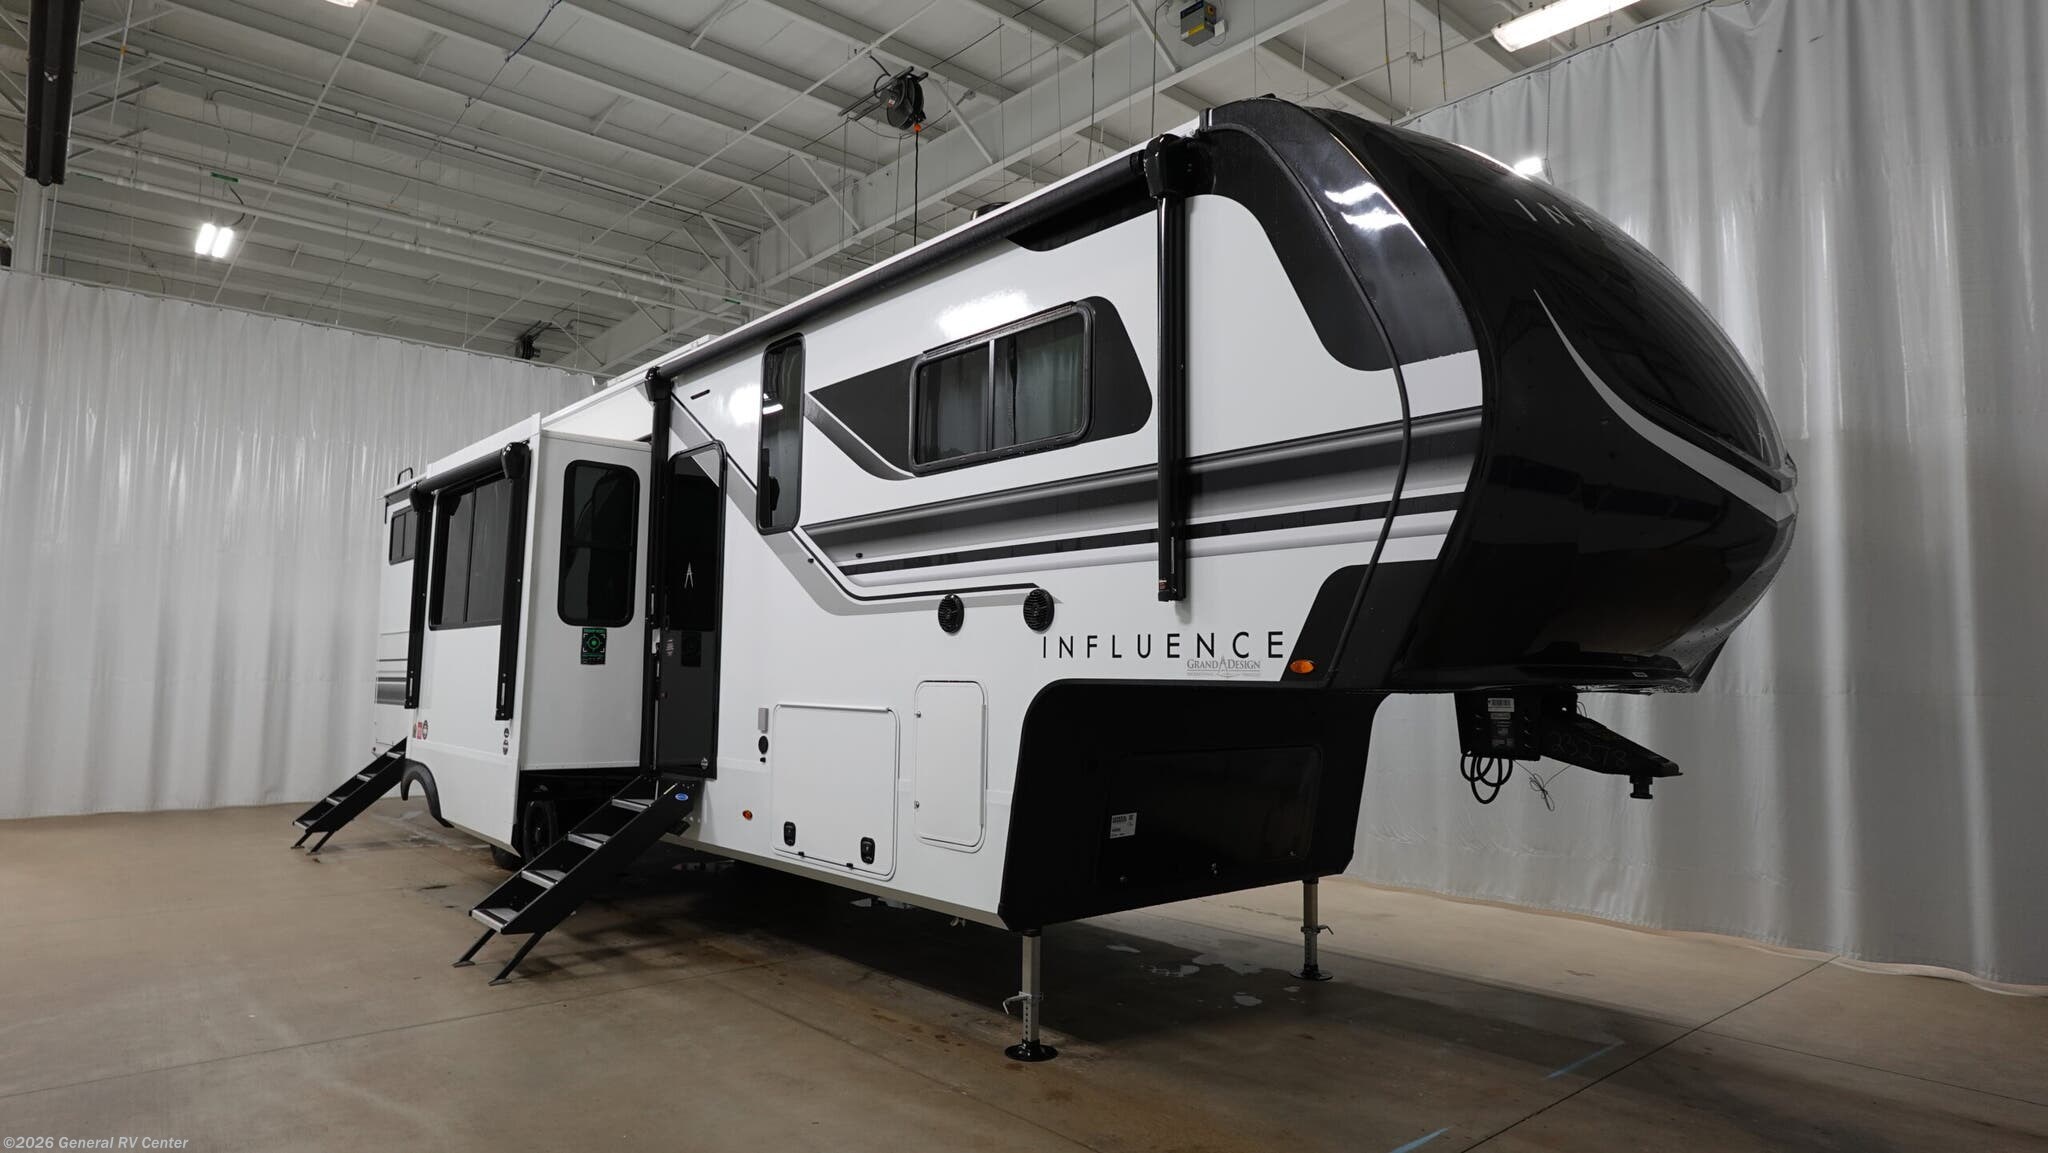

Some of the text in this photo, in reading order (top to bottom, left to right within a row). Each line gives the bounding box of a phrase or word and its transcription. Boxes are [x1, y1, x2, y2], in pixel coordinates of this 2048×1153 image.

[1043, 631, 1284, 658] INFLUENCE
[1186, 659, 1261, 669] GRAND DESIGN
